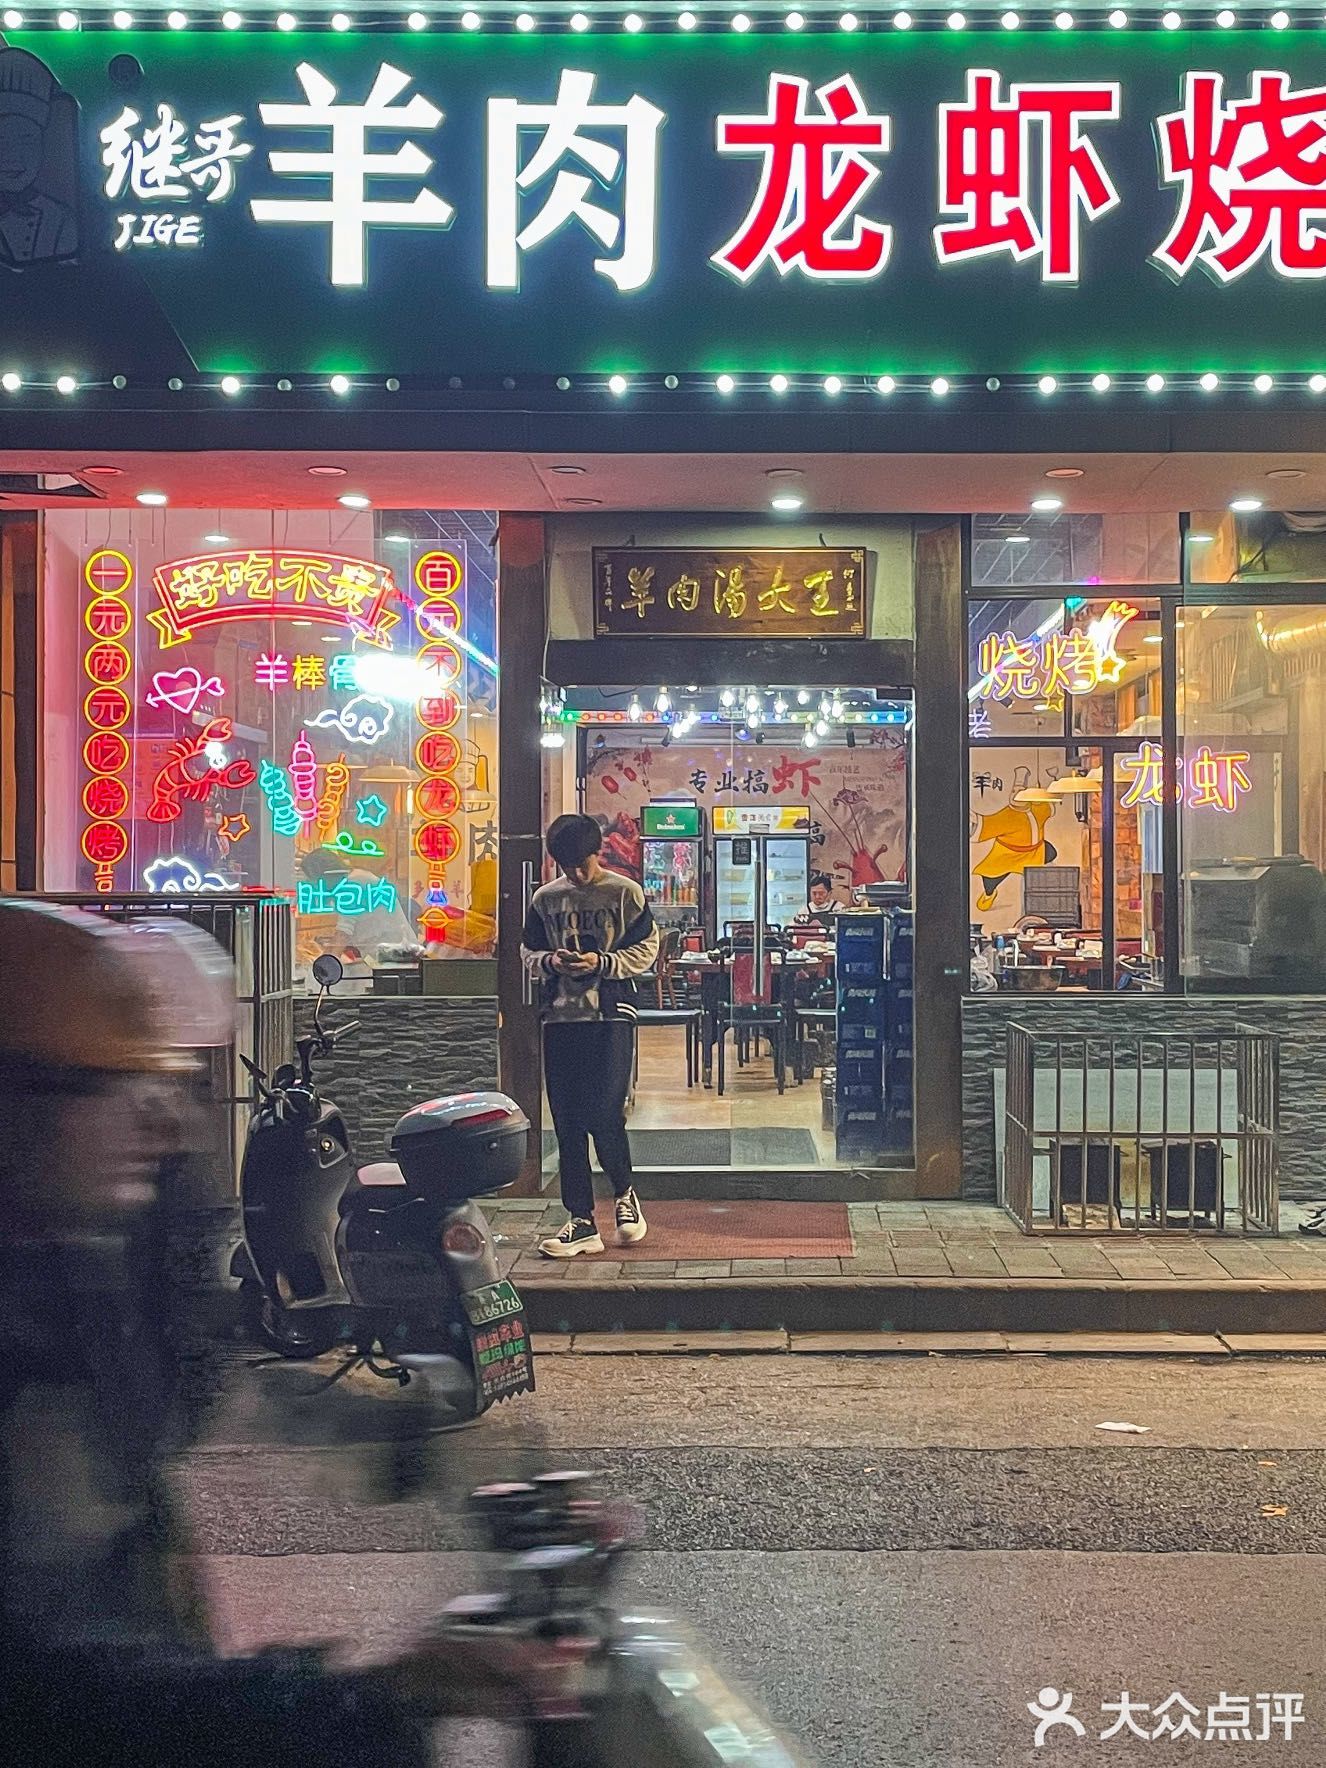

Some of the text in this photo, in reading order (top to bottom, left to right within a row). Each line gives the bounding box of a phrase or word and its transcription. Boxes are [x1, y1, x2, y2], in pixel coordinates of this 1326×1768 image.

[100, 104, 254, 202] 继哥
[114, 212, 203, 251] JIGE
[169, 552, 379, 615] 好吃不贵
[979, 630, 1099, 699] 烧烤
[87, 562, 128, 860] 一元两元吃烧烤
[419, 558, 457, 860] 百元不到吃龙虾
[1120, 741, 1252, 813] 龙虾
[298, 876, 397, 914] 肚包肉
